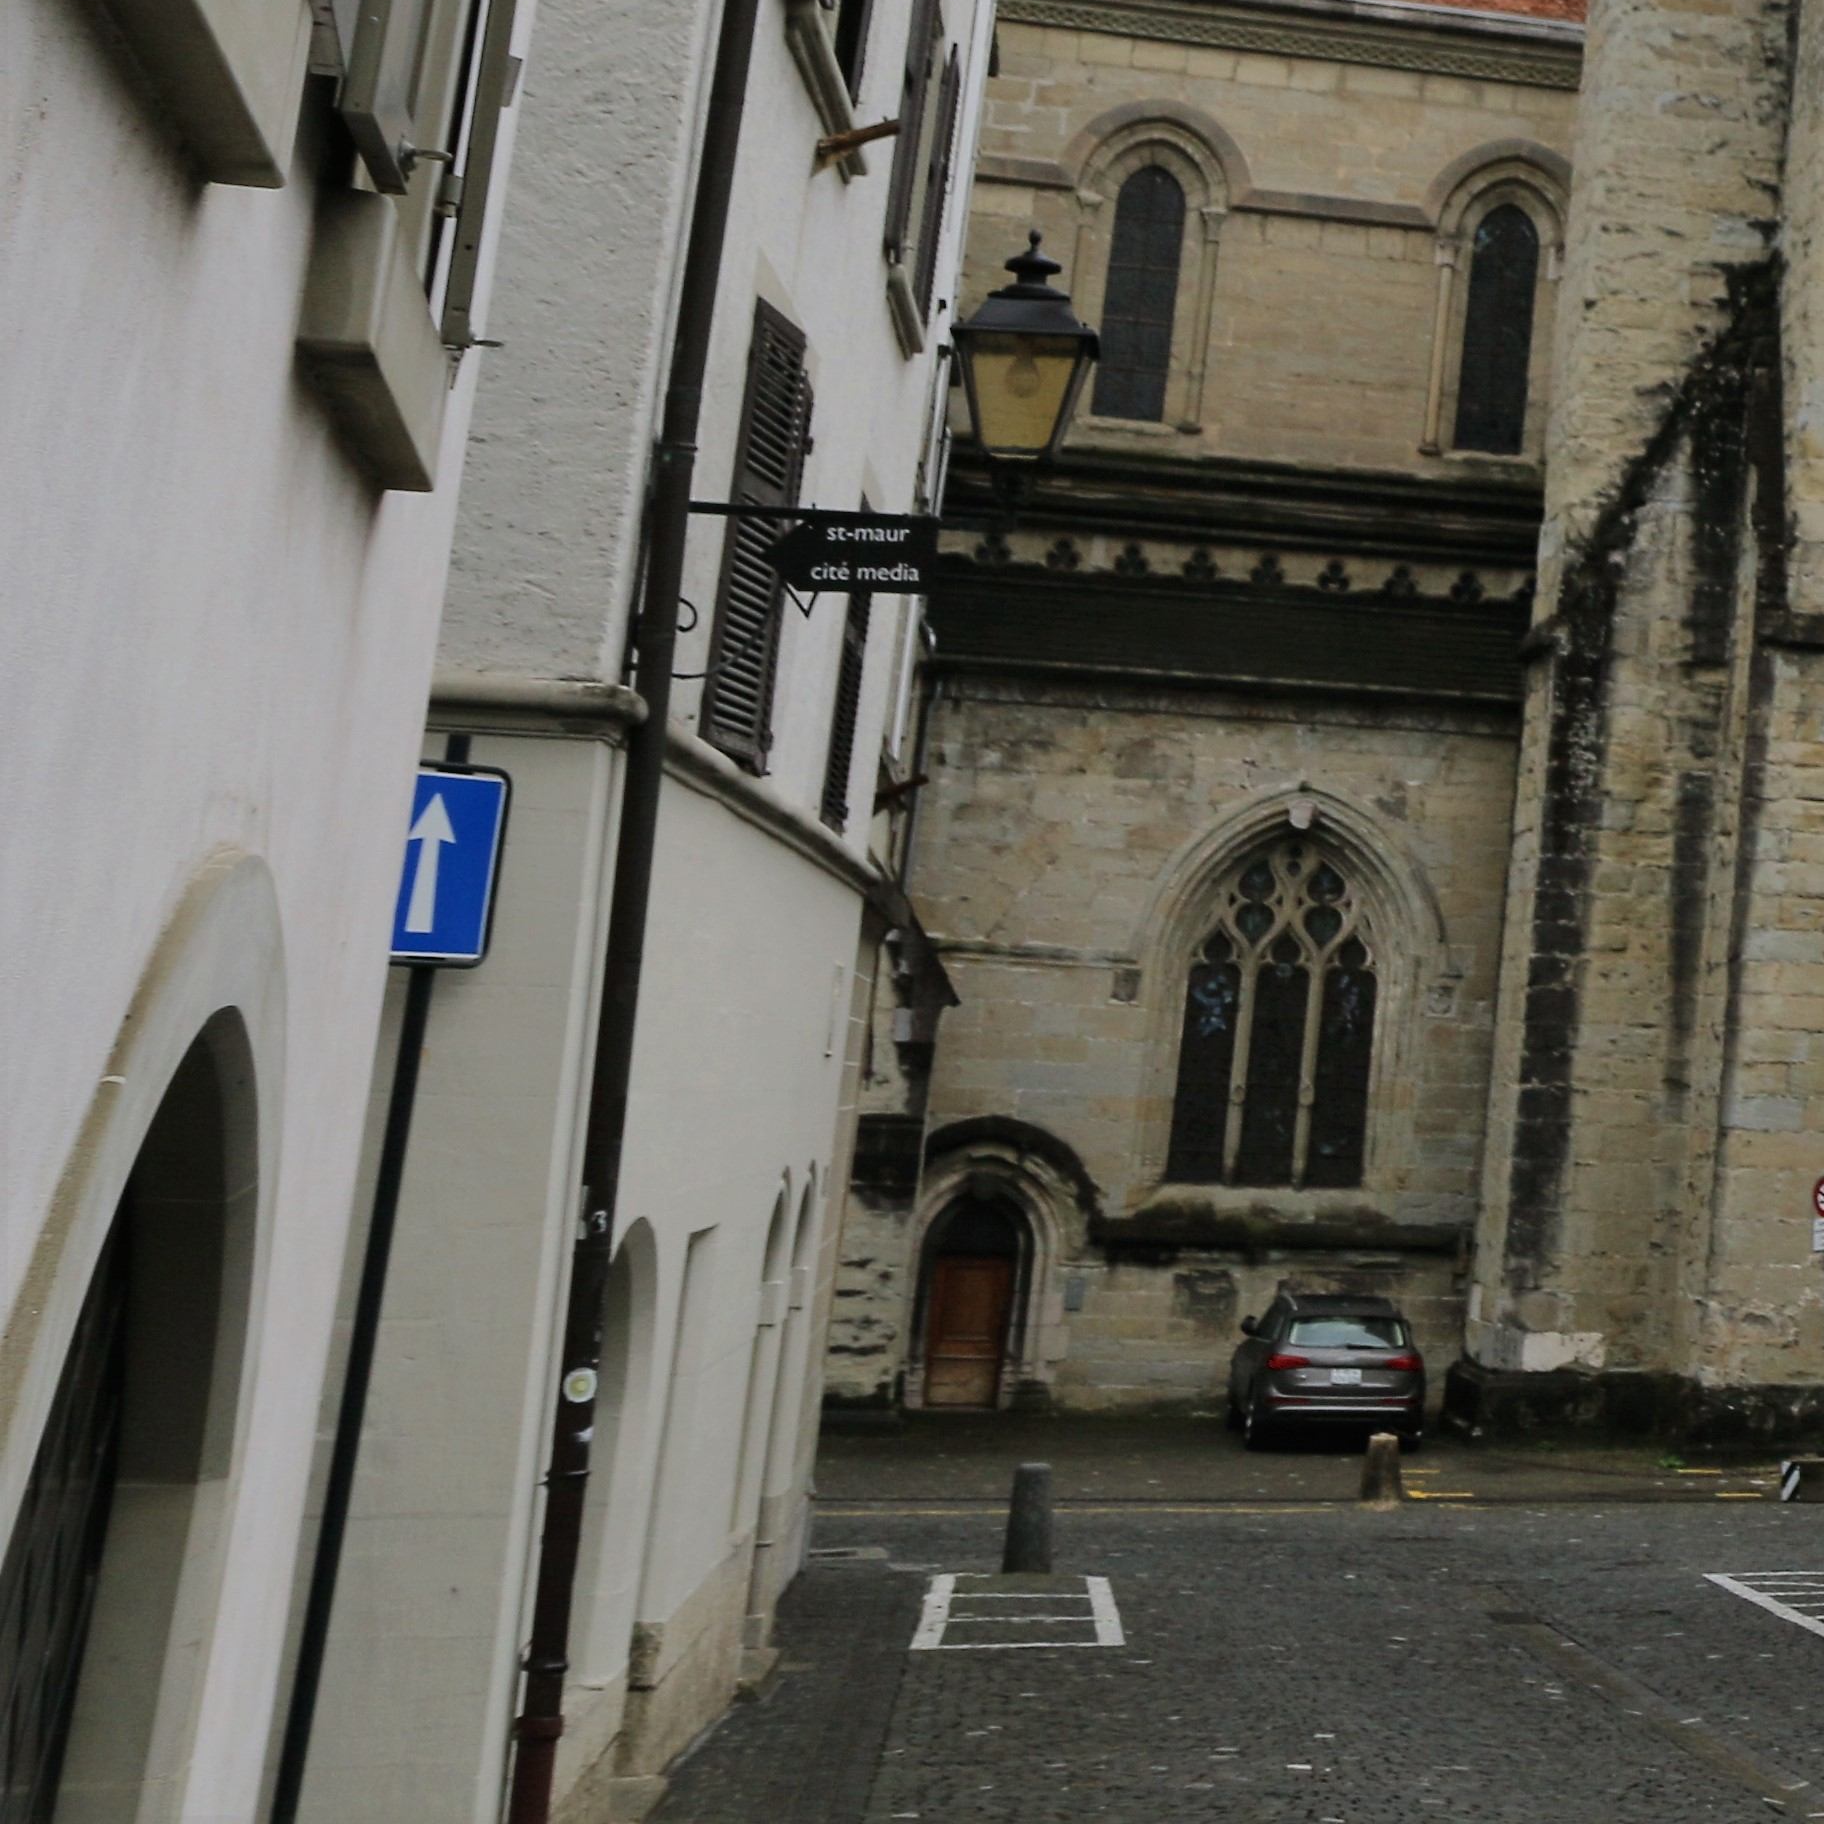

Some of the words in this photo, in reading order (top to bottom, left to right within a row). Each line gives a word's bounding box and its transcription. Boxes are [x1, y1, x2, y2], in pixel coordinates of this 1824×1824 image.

[826, 526, 911, 542] st-maur
[810, 560, 850, 581] cité
[856, 562, 920, 582] media
